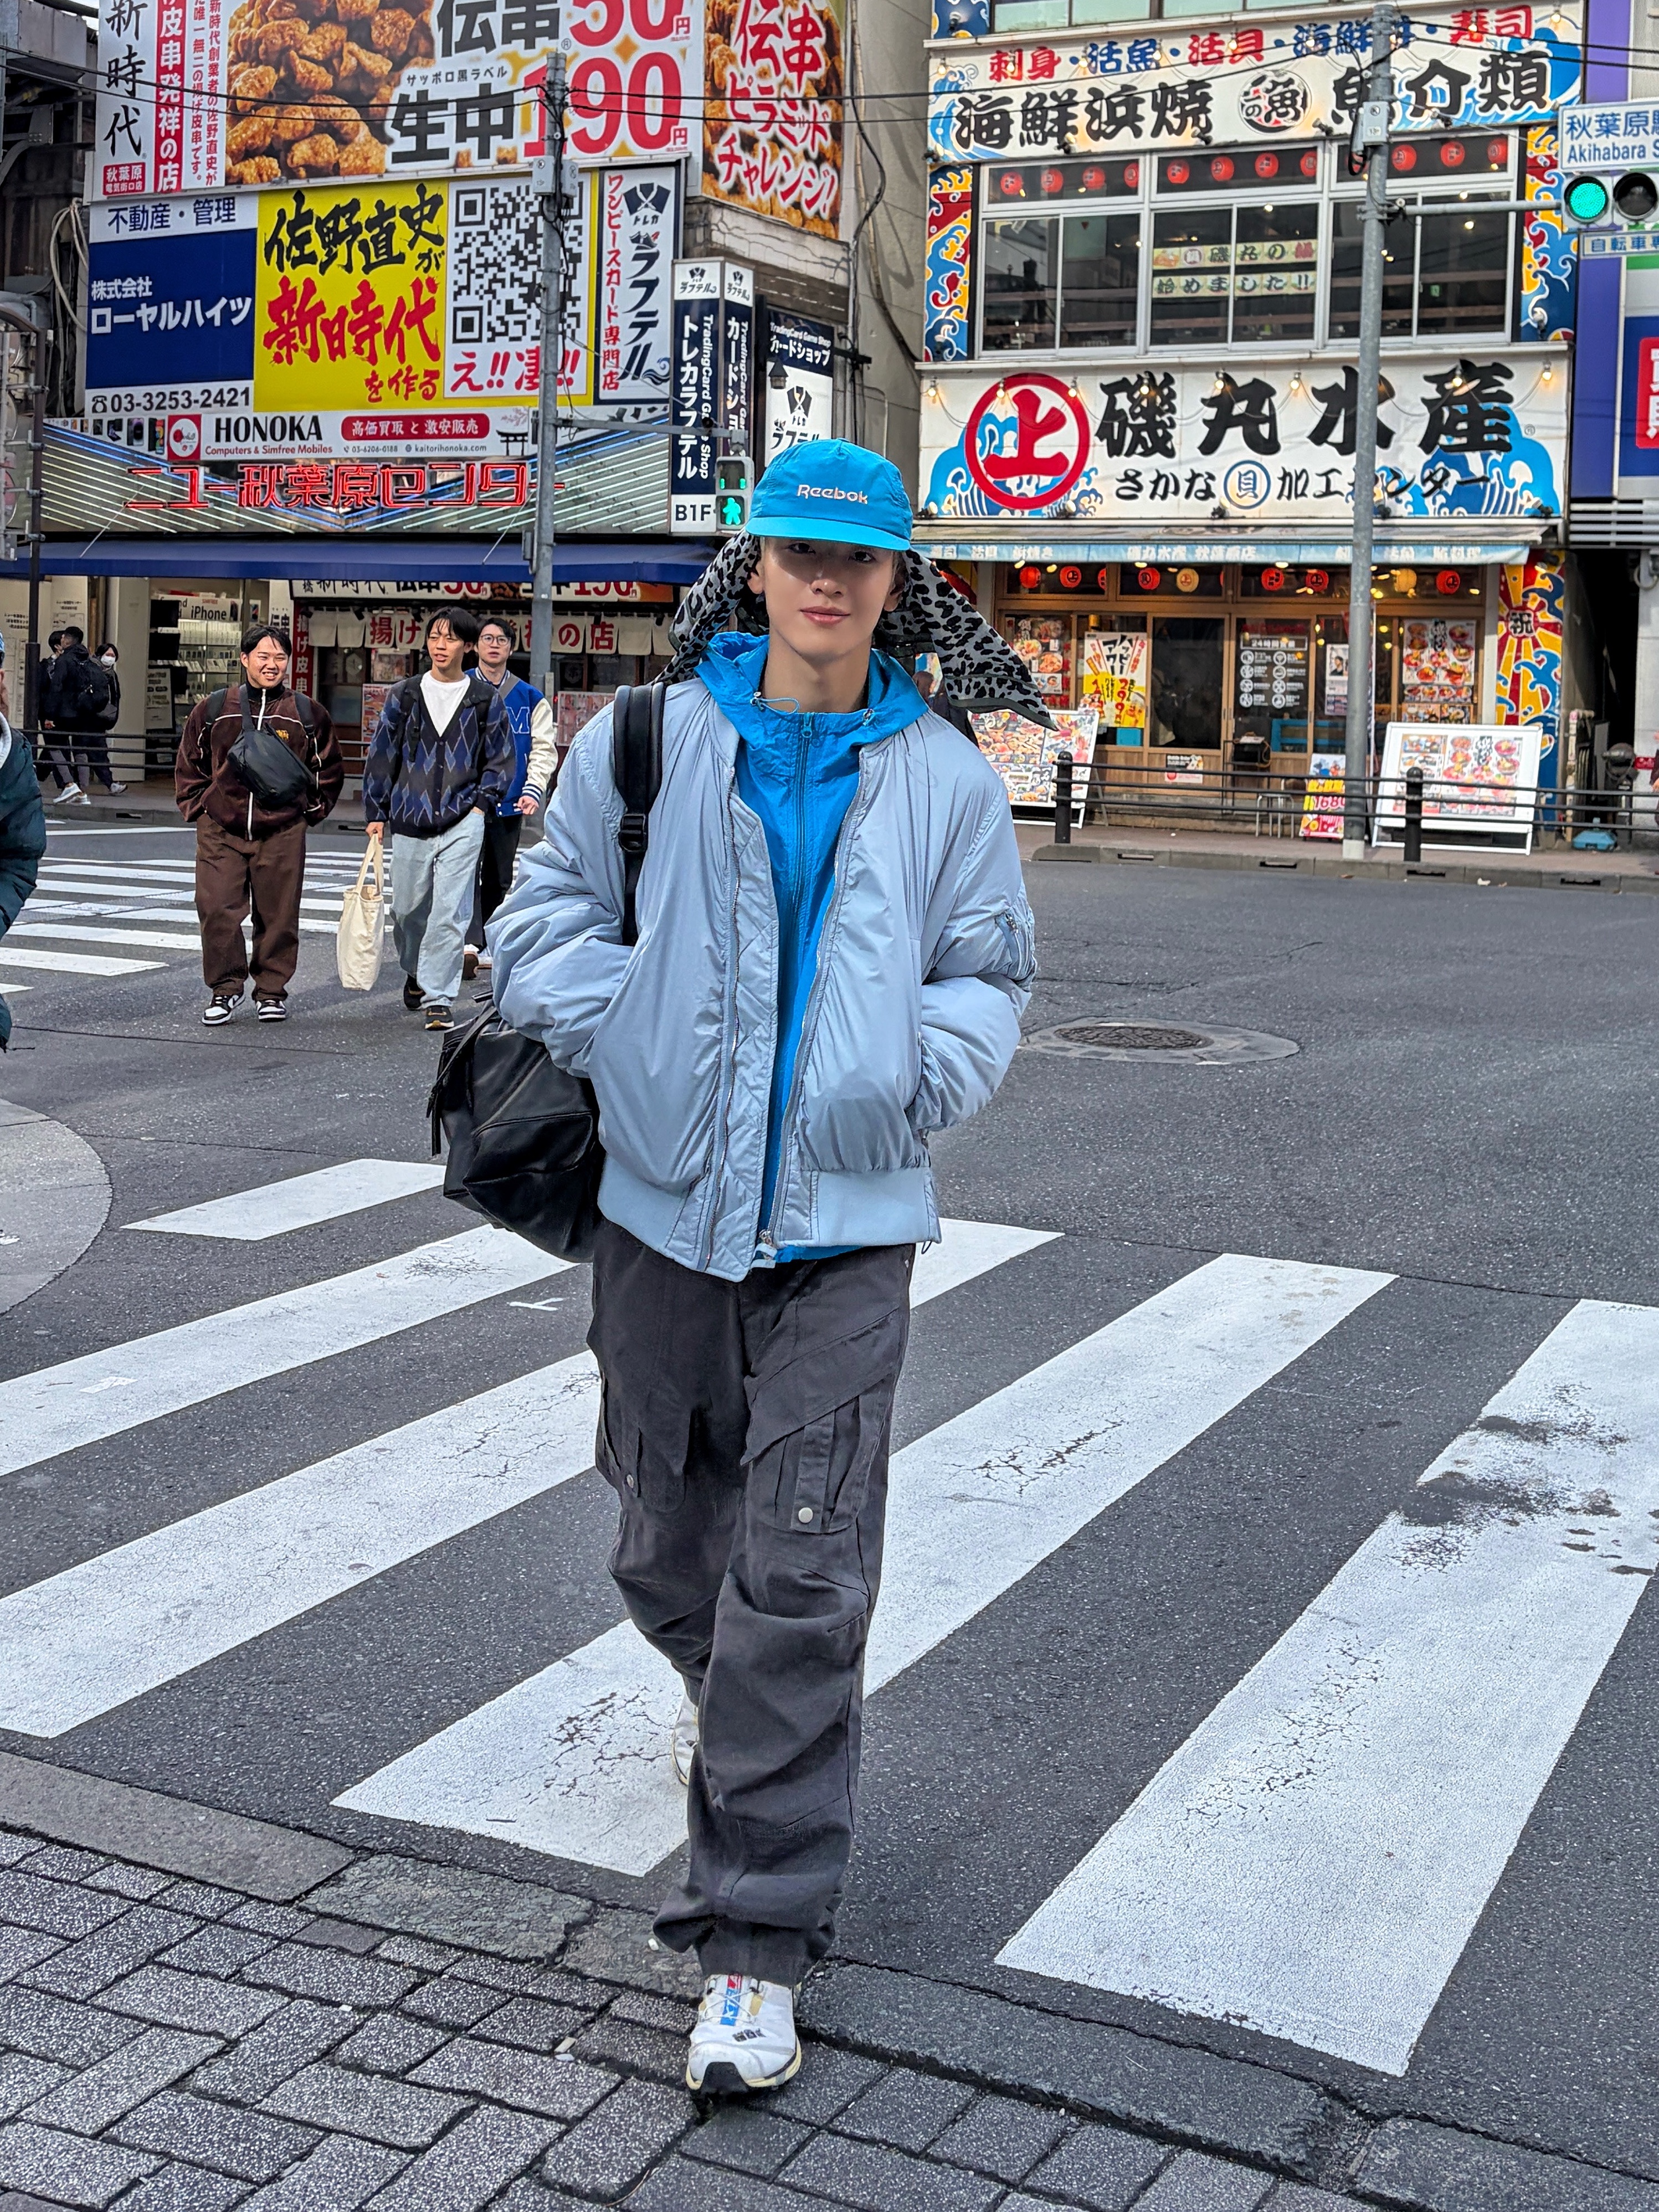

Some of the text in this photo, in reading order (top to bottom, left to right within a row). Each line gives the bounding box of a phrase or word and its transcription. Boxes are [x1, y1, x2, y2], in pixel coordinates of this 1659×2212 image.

[104, 0, 148, 157] 新時代
[407, 64, 508, 86] サッポロ黒ラベル
[156, 0, 183, 192] 皮串発祥の店
[392, 83, 514, 163] 生中
[1568, 142, 1646, 163] Akihabara
[106, 165, 142, 182] 秋葉原
[108, 197, 236, 234] 不動産・管理
[633, 214, 659, 226] トレカ
[91, 276, 153, 301] 株式会社
[602, 175, 624, 391] ワンピースカード専門店
[91, 297, 253, 333] ローヤルハイツ
[263, 275, 442, 366] 新時代
[617, 244, 660, 381] ラフテル
[770, 335, 831, 367] カードショップ
[365, 366, 441, 403] を作る
[677, 315, 699, 479] トレカラフテル
[1095, 359, 1515, 459] 磯丸水産
[215, 415, 323, 443] HONOKA
[352, 420, 404, 437] 高価買取
[410, 421, 419, 435] と
[205, 444, 333, 459] Computers & Simfree Mobiles
[415, 443, 487, 453] kaitorihonoka.com
[700, 444, 711, 480] Shop
[797, 484, 869, 505] Reebok
[1116, 468, 1217, 501] さかな
[1276, 466, 1491, 502] 加工ンター
[675, 504, 712, 522] B1F
[191, 605, 228, 620] iPhone
[506, 706, 530, 734] M
